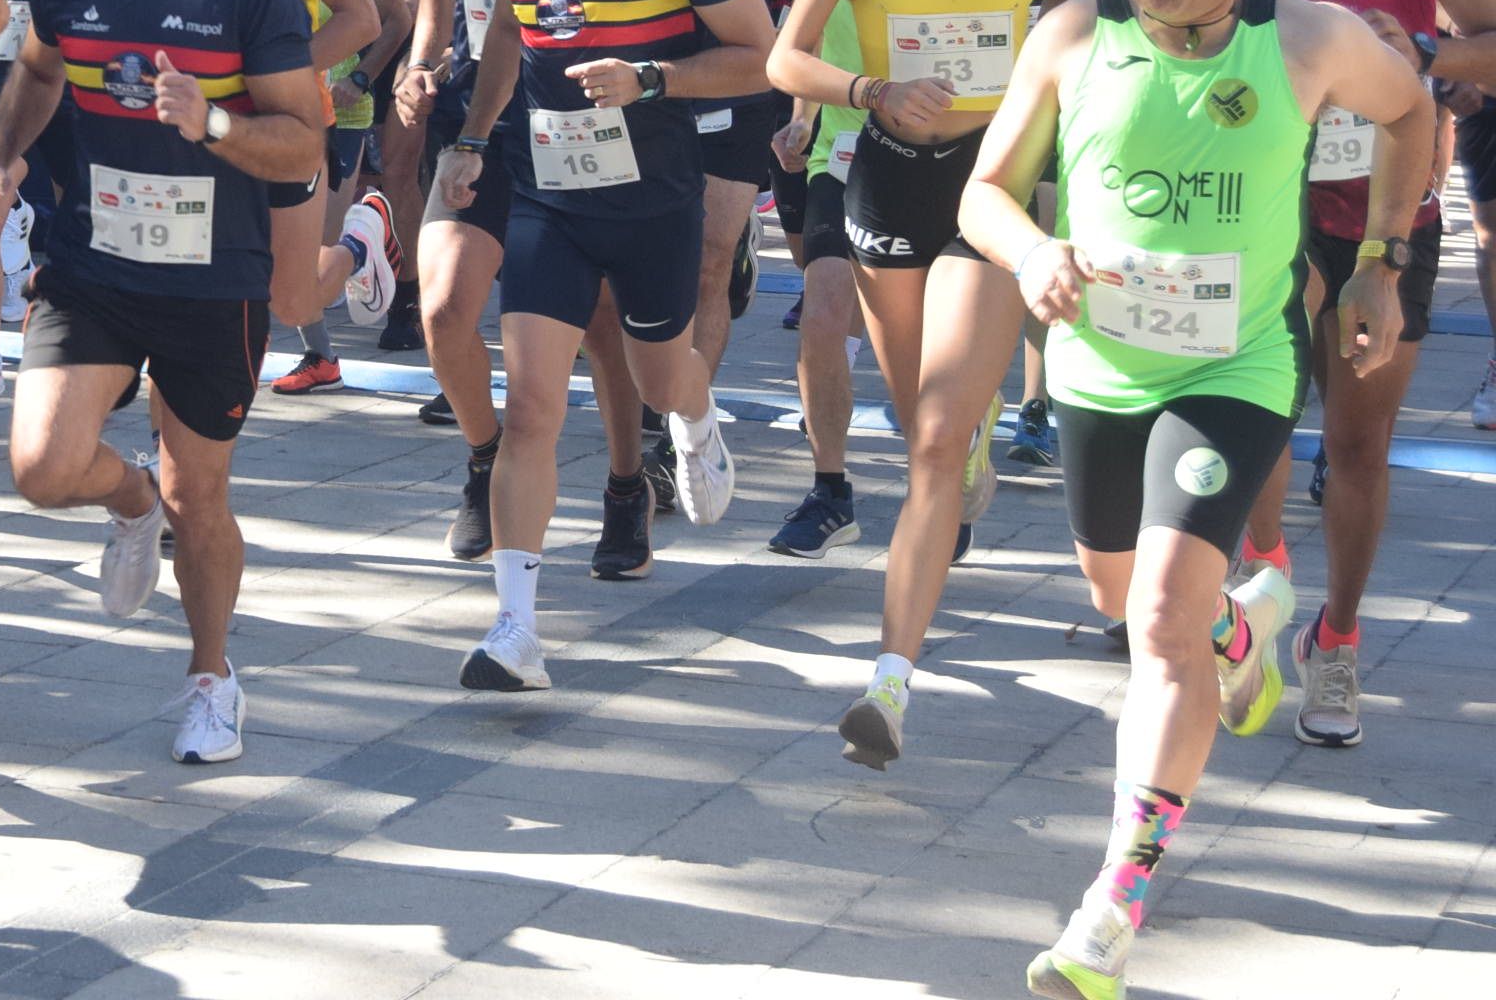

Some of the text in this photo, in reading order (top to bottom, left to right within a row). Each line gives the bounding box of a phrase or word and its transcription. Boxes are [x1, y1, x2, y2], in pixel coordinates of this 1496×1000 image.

[186, 20, 223, 37] mupol
[933, 58, 974, 82] 53
[880, 136, 917, 158] PRO
[564, 153, 599, 176] 16
[130, 222, 170, 248] 19
[844, 216, 915, 256] NIKE
[1126, 302, 1200, 339] 124
